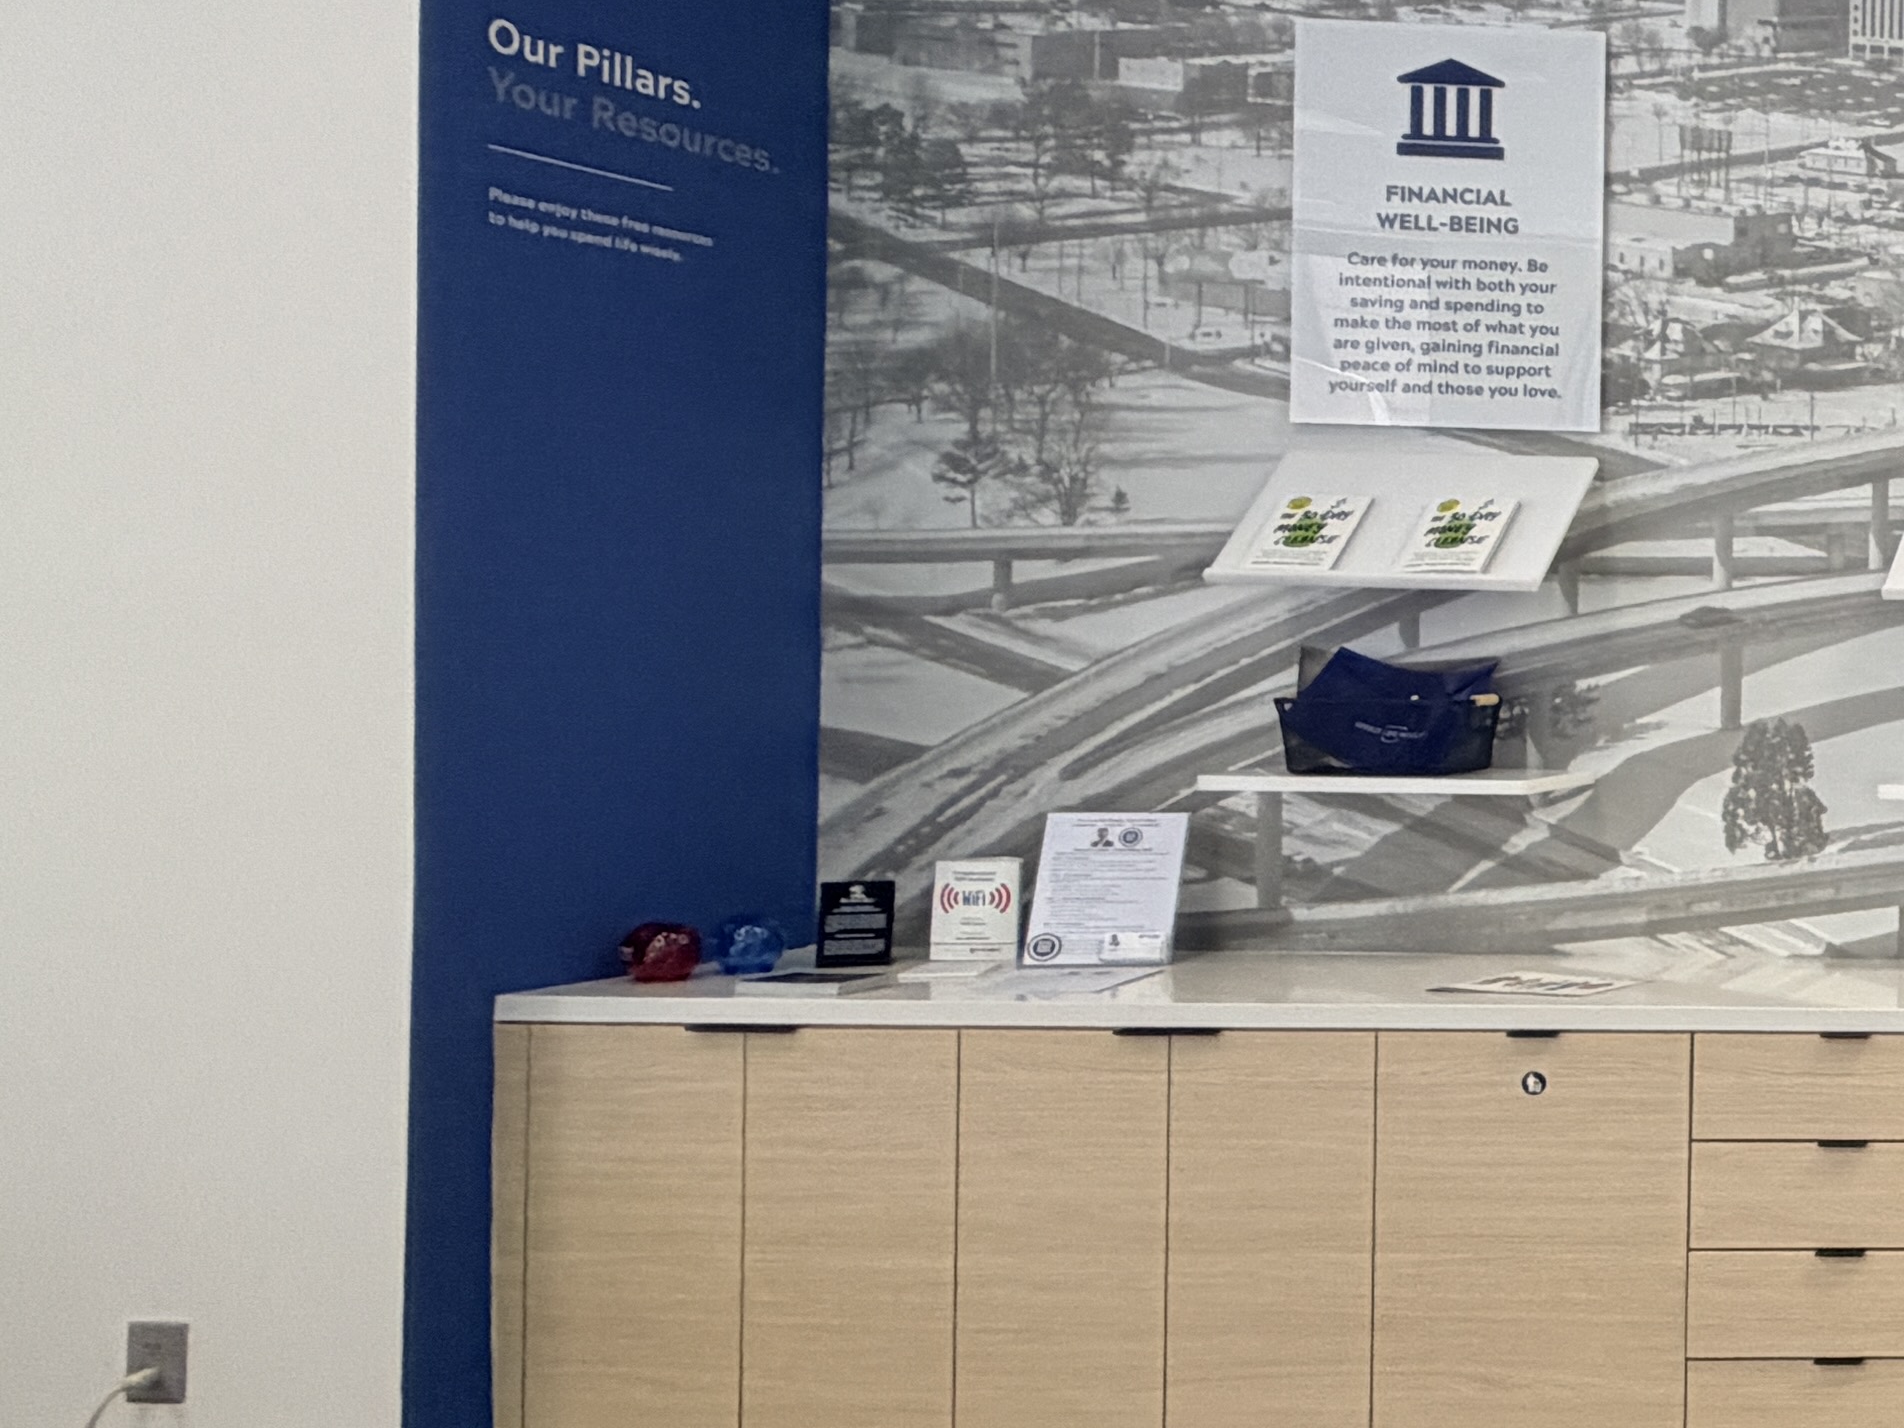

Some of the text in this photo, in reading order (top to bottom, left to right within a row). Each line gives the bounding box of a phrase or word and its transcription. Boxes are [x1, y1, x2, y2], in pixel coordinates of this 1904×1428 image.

[488, 19, 701, 108] Our Pillars.
[487, 66, 779, 173] Your Resources.
[1386, 185, 1512, 206] FINANCIAL
[538, 202, 578, 219] enjoy
[489, 211, 505, 225] to
[508, 215, 540, 234] help
[1376, 213, 1519, 234] WELL-BEING
[1347, 252, 1549, 274] Care for your money. Be
[1339, 273, 1557, 296] intentional with both your
[1350, 296, 1545, 317] saving and spending to
[1334, 316, 1559, 338] make the most of what you
[1333, 338, 1559, 358] are given, gaining financial
[1340, 358, 1552, 380] peace of mind to support
[1328, 379, 1562, 399] yourself and those you love.
